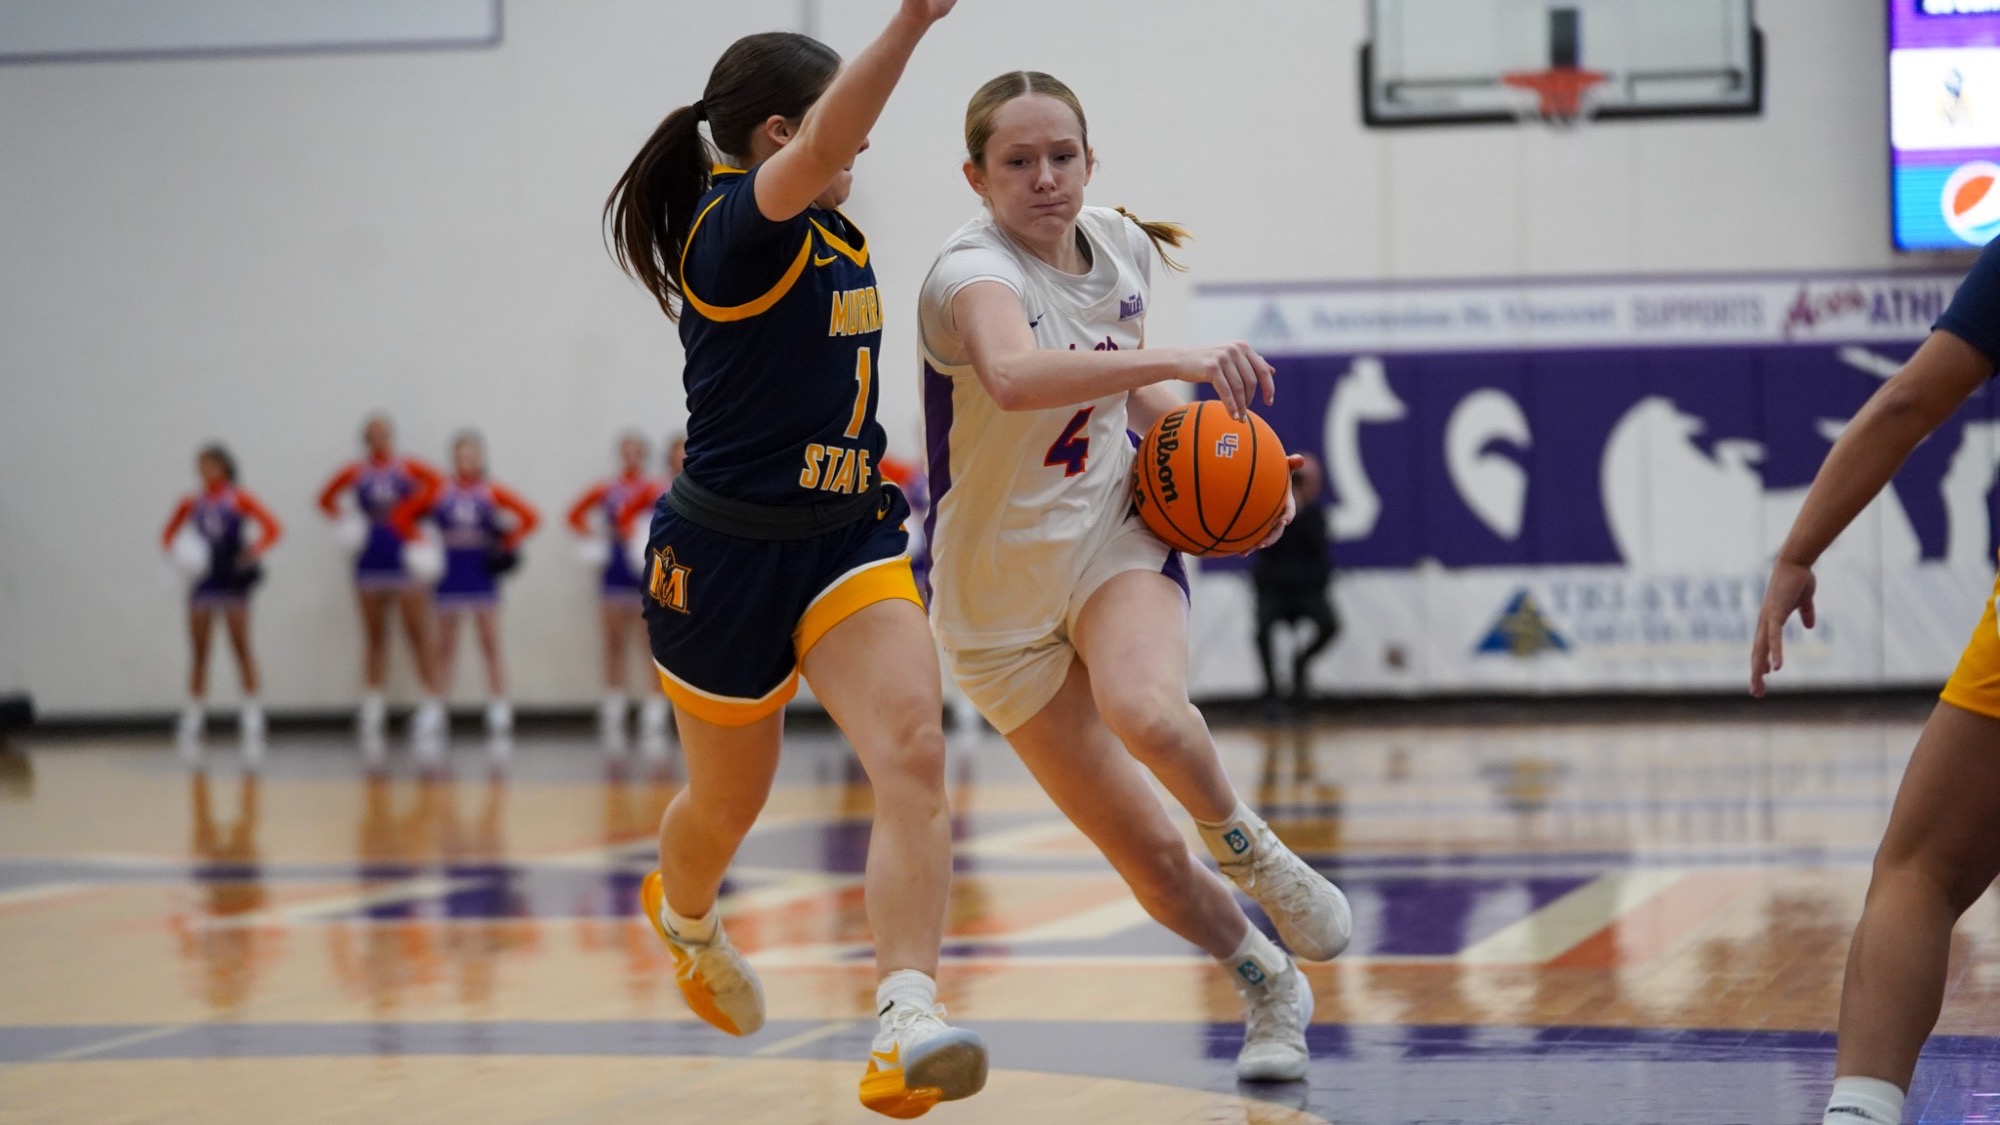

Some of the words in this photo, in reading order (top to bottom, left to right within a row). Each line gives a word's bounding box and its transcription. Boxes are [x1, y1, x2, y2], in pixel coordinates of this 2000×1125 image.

[1633, 296, 1765, 330] SUPPORTS
[843, 347, 871, 439] 1
[1043, 405, 1096, 478] 4
[1156, 408, 1189, 505] Wilson
